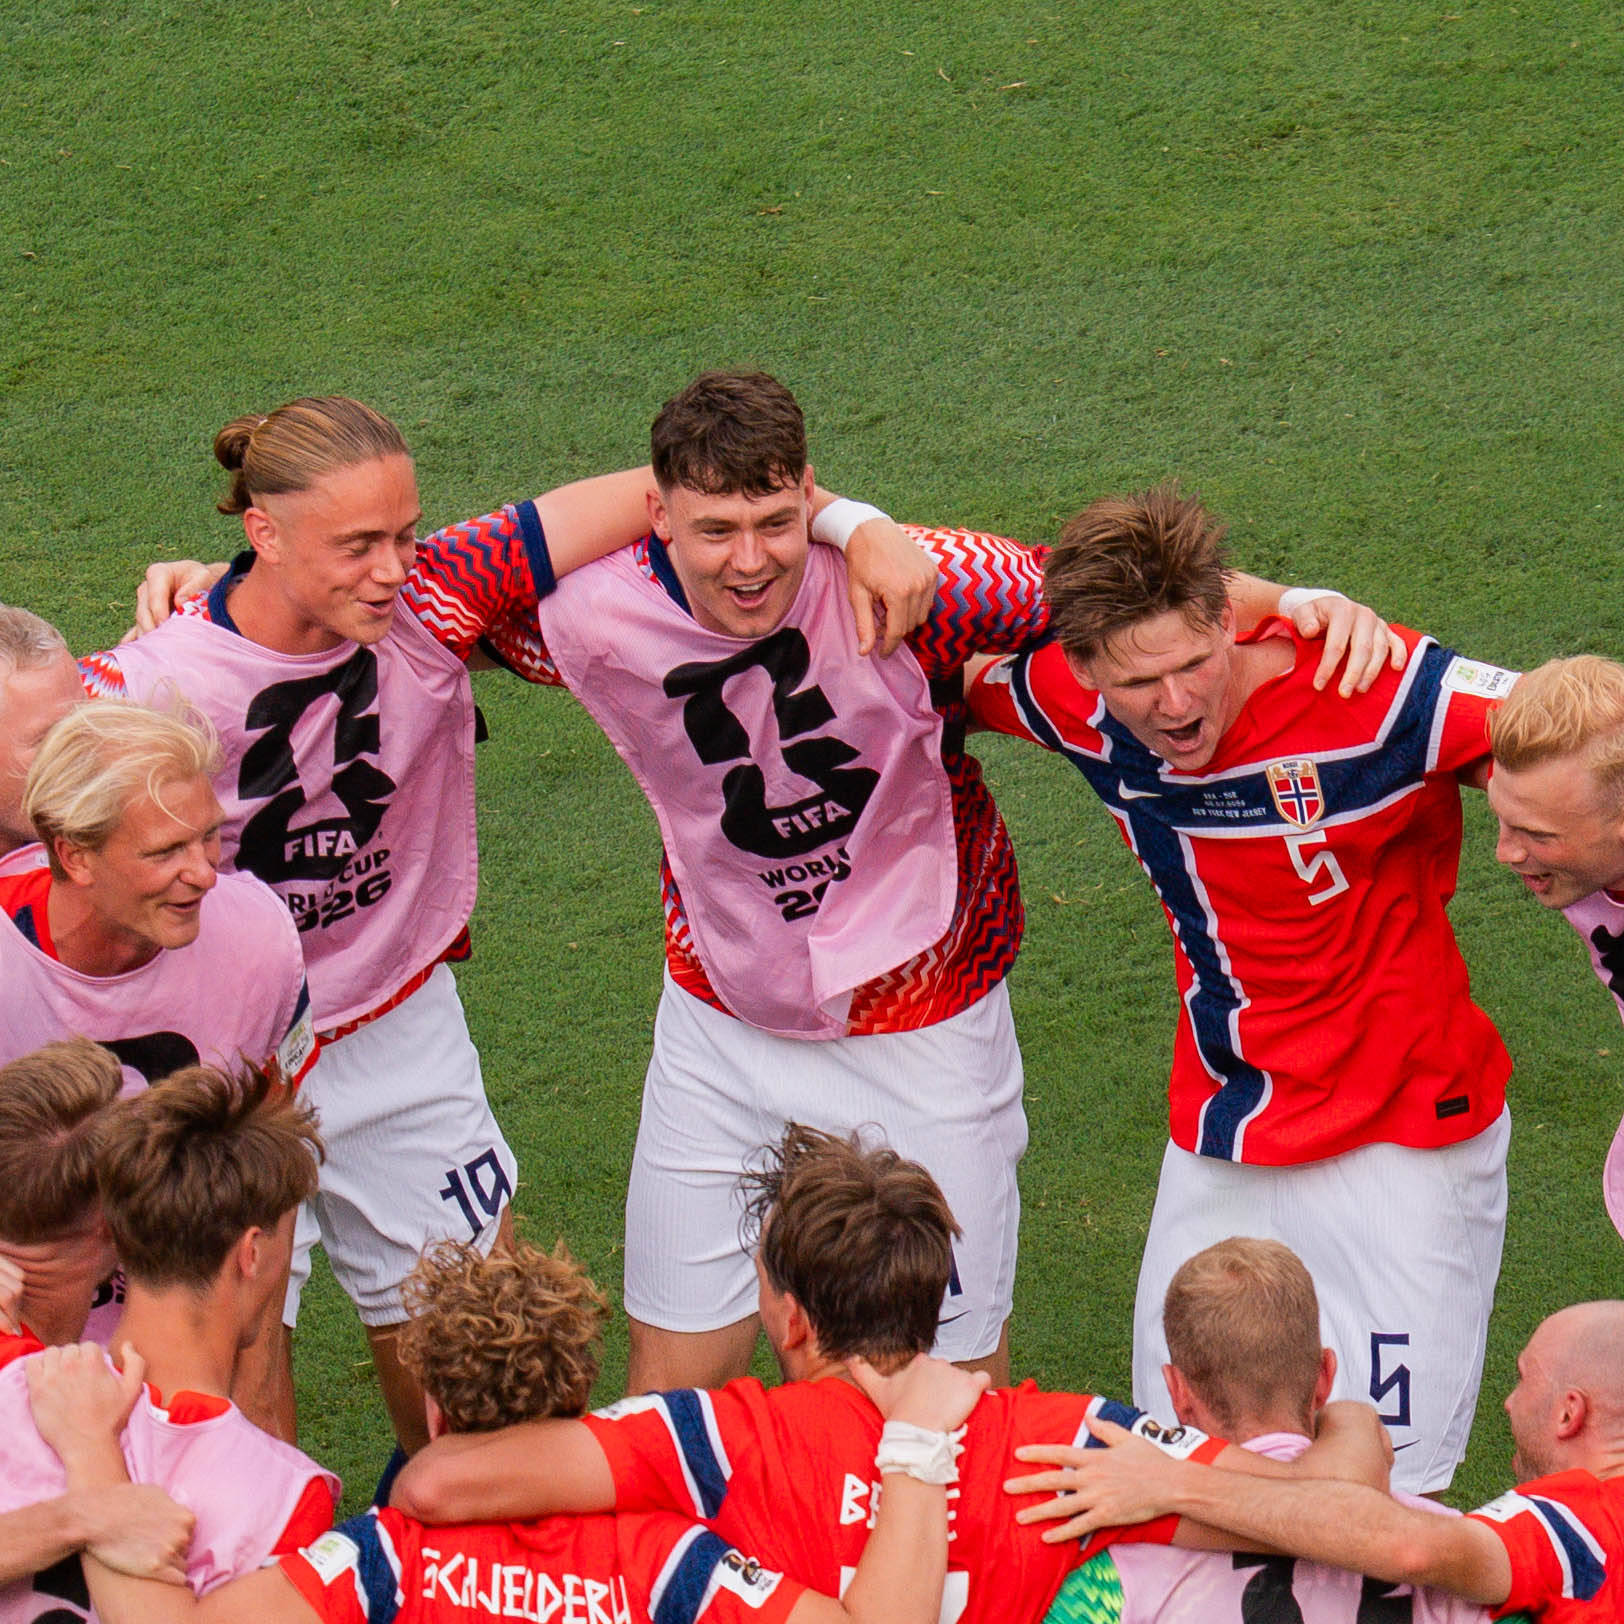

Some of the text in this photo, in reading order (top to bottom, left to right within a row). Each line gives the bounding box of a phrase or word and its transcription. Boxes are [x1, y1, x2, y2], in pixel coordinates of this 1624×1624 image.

[771, 800, 852, 839] FIFA
[284, 830, 359, 862] FIFA
[338, 849, 391, 884] CUP
[1284, 829, 1350, 906] 5
[1369, 1331, 1411, 1426] 5
